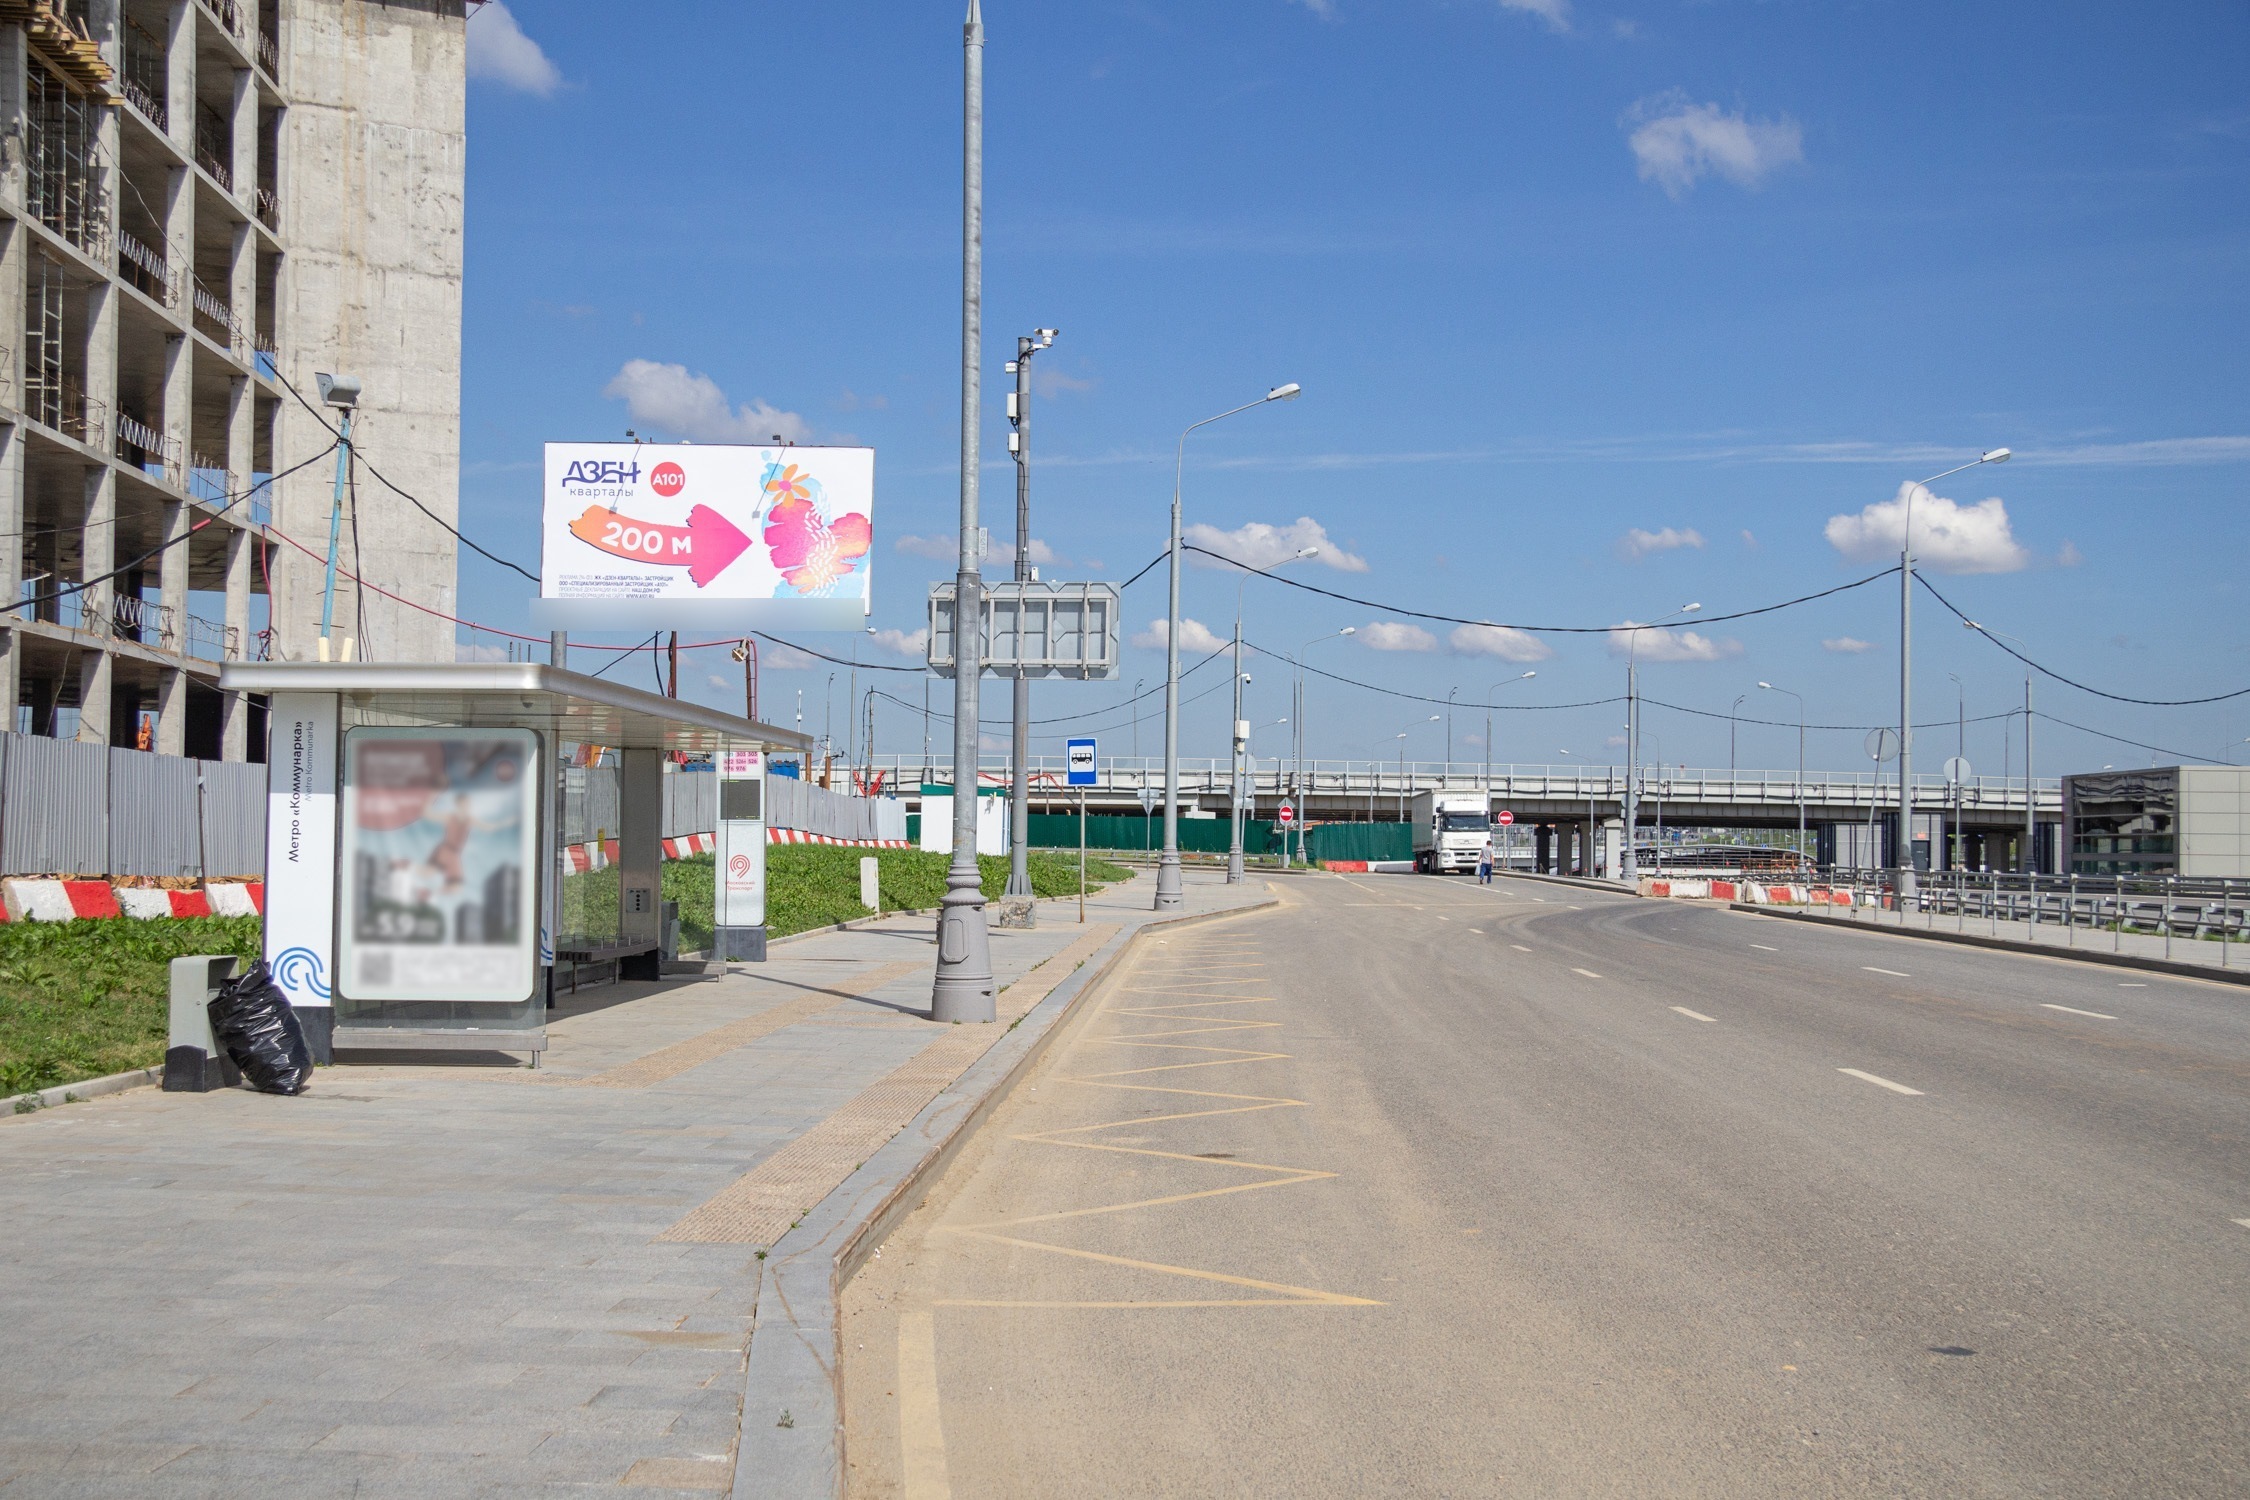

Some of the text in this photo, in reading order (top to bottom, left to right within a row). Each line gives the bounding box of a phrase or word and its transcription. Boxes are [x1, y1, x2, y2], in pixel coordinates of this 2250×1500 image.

[562, 461, 641, 487] ДЗЕН
[652, 473, 684, 486] А101
[570, 488, 634, 499] кварталы
[601, 521, 663, 555] 200
[305, 721, 314, 802] Metro Kommunarka
[288, 721, 304, 863] Метро «Коммунарка»
